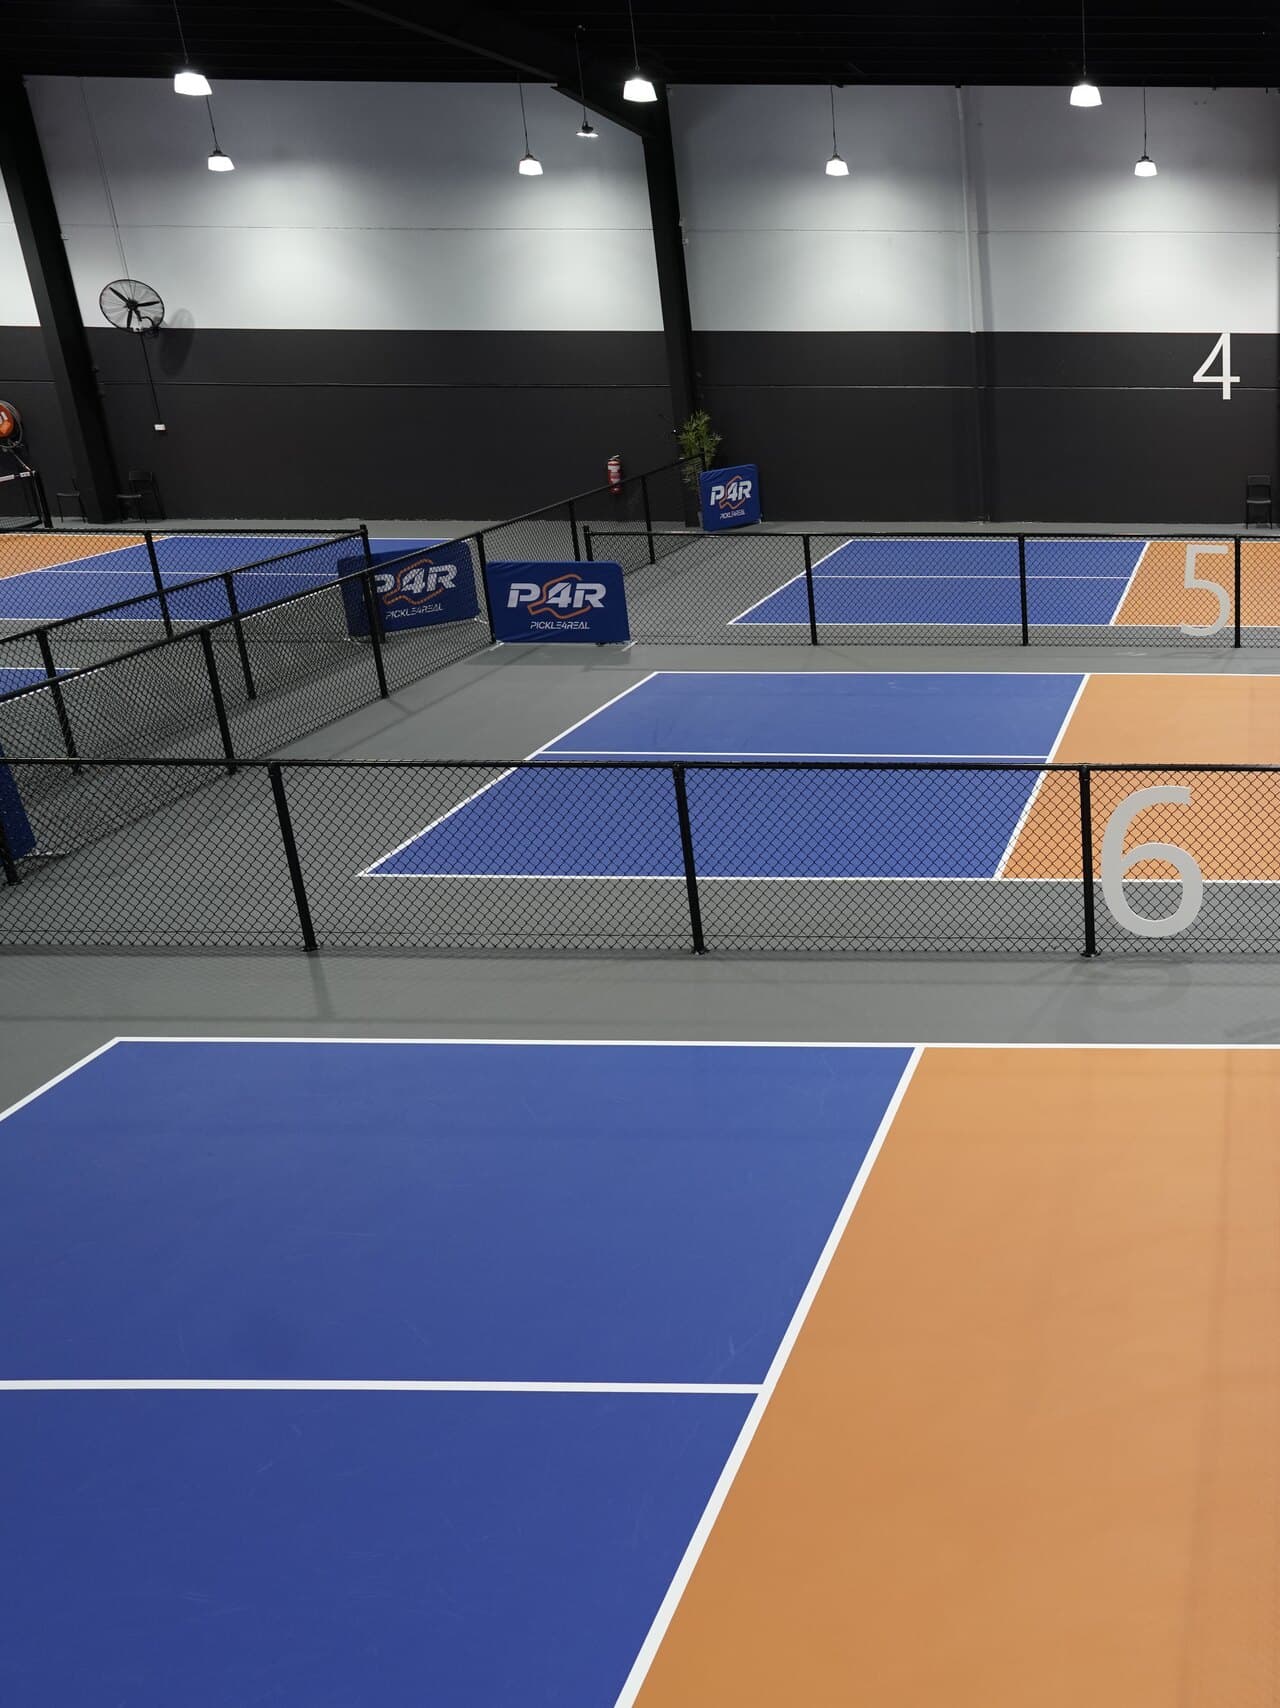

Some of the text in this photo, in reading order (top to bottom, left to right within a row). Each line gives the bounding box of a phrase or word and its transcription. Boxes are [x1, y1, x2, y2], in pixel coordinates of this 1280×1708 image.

[1192, 332, 1241, 400] 4
[710, 480, 752, 506] P4R
[507, 582, 606, 608] P4R
[1179, 544, 1232, 638] 5
[530, 621, 590, 630] PICKLE4REAL
[1100, 784, 1205, 938] 6
